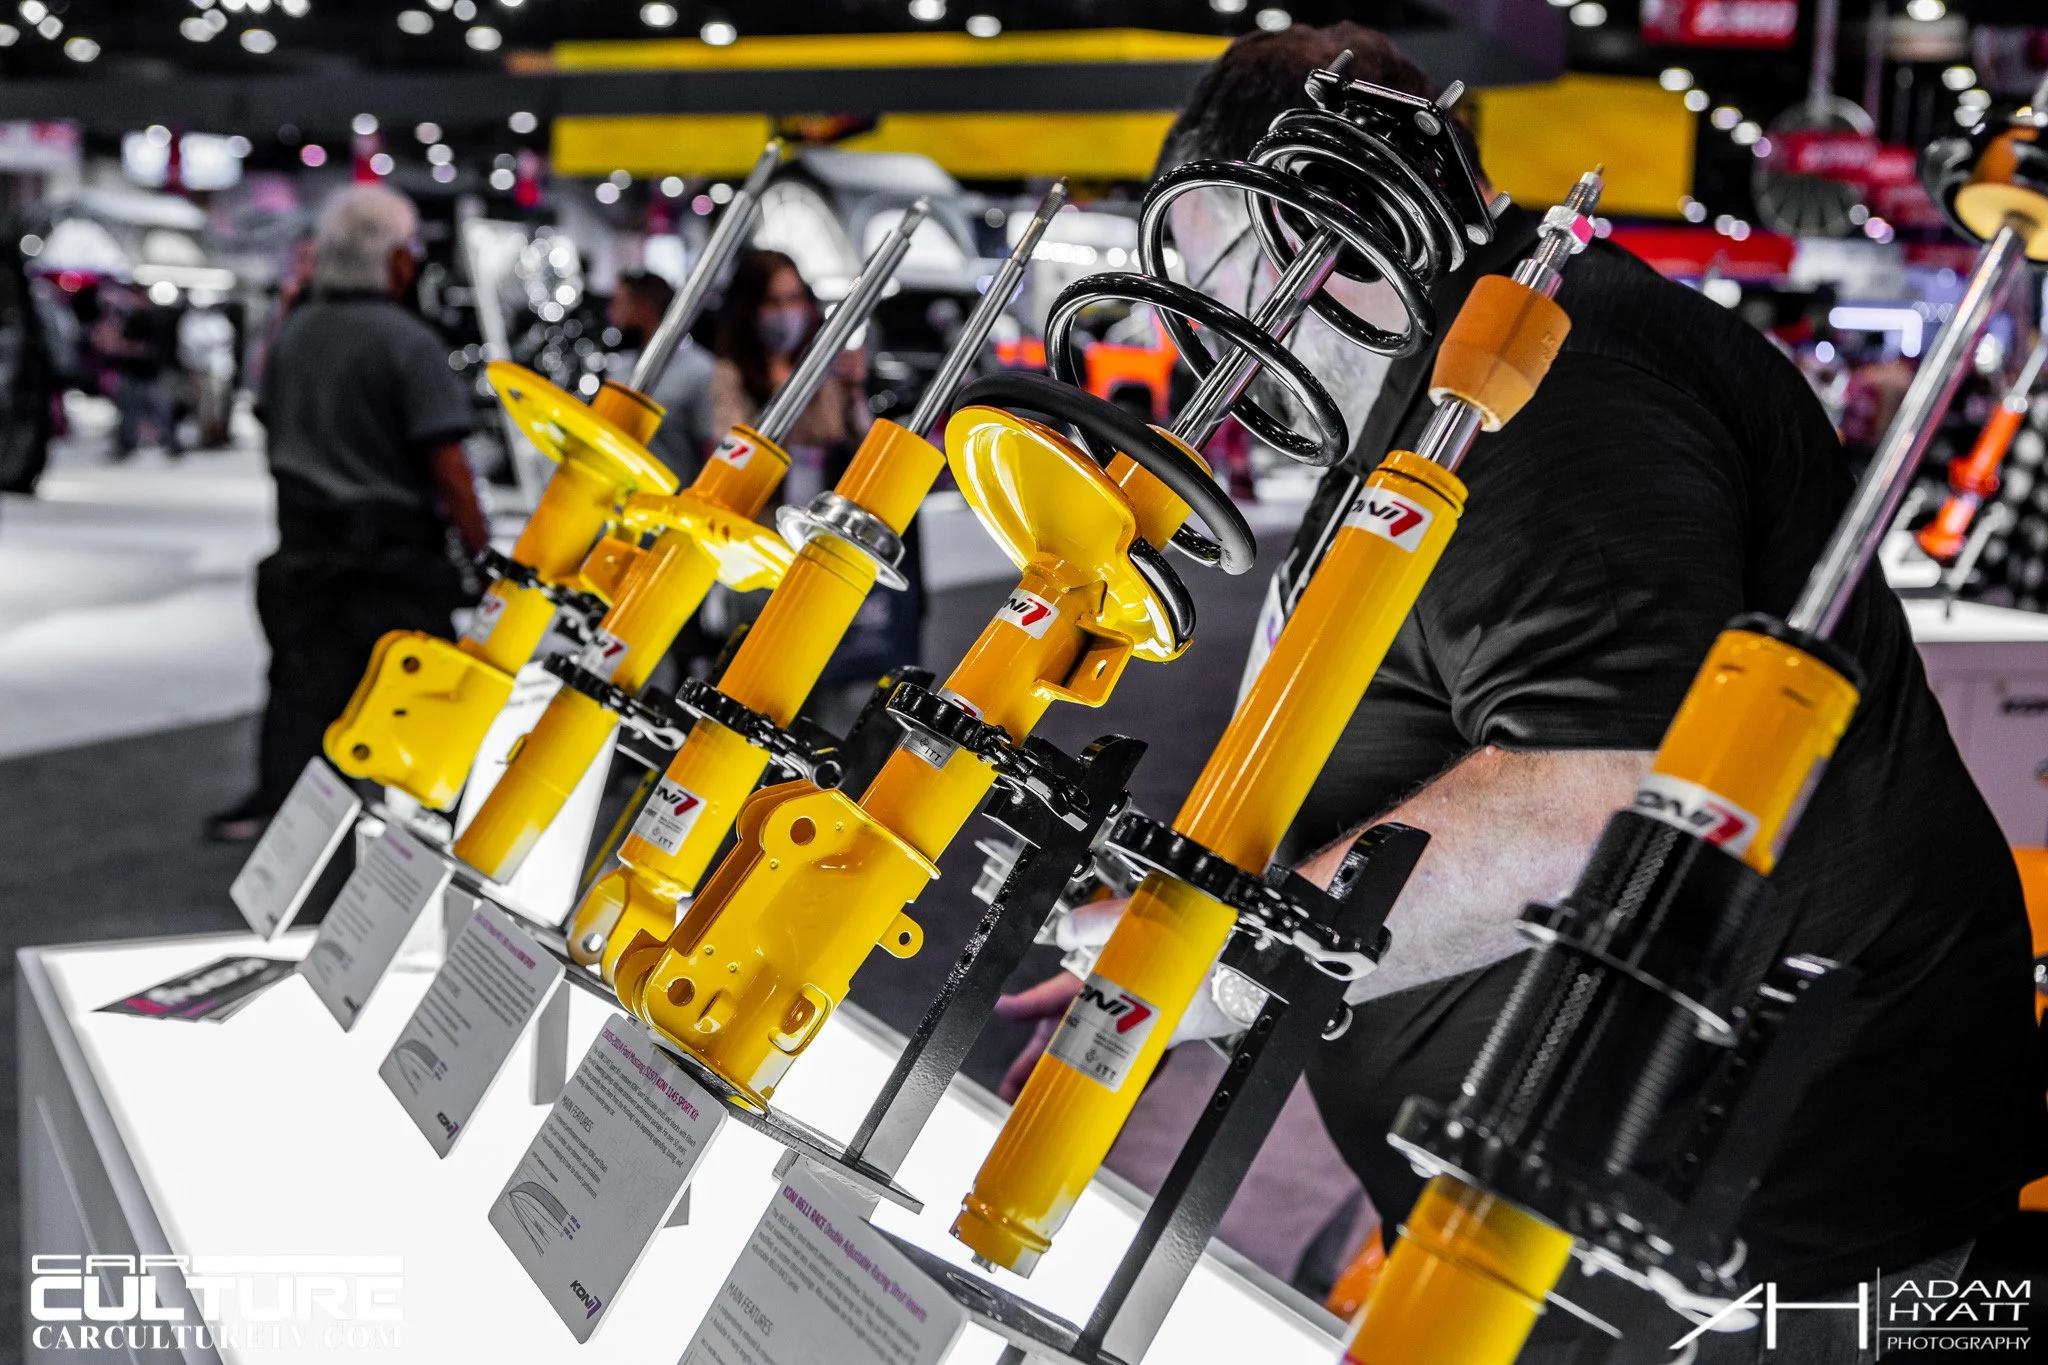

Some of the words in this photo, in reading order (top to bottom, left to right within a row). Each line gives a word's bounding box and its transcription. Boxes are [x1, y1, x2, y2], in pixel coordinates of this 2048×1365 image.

[925, 747, 942, 761] ITT
[658, 836, 674, 849] ITT
[629, 1052, 645, 1074] Mustang
[643, 1066, 658, 1084] (S197)
[655, 1077, 668, 1091] KONI
[666, 1086, 679, 1102] 1145
[676, 1096, 693, 1114] SPORT
[690, 1108, 698, 1121] Kit
[562, 1095, 573, 1112] MAIN
[635, 1104, 652, 1121] performance
[673, 1139, 679, 1147] 50
[664, 1116, 672, 1124] and
[670, 1121, 680, 1132] shocks
[679, 1130, 687, 1138] with
[783, 1186, 798, 1203] KONI
[810, 1210, 826, 1229] RACE
[824, 1223, 843, 1246] Double
[842, 1240, 871, 1271] Adjustable
[788, 1223, 798, 1236] RACE
[570, 1280, 596, 1310] KONI
[726, 1282, 744, 1305] MAIN
